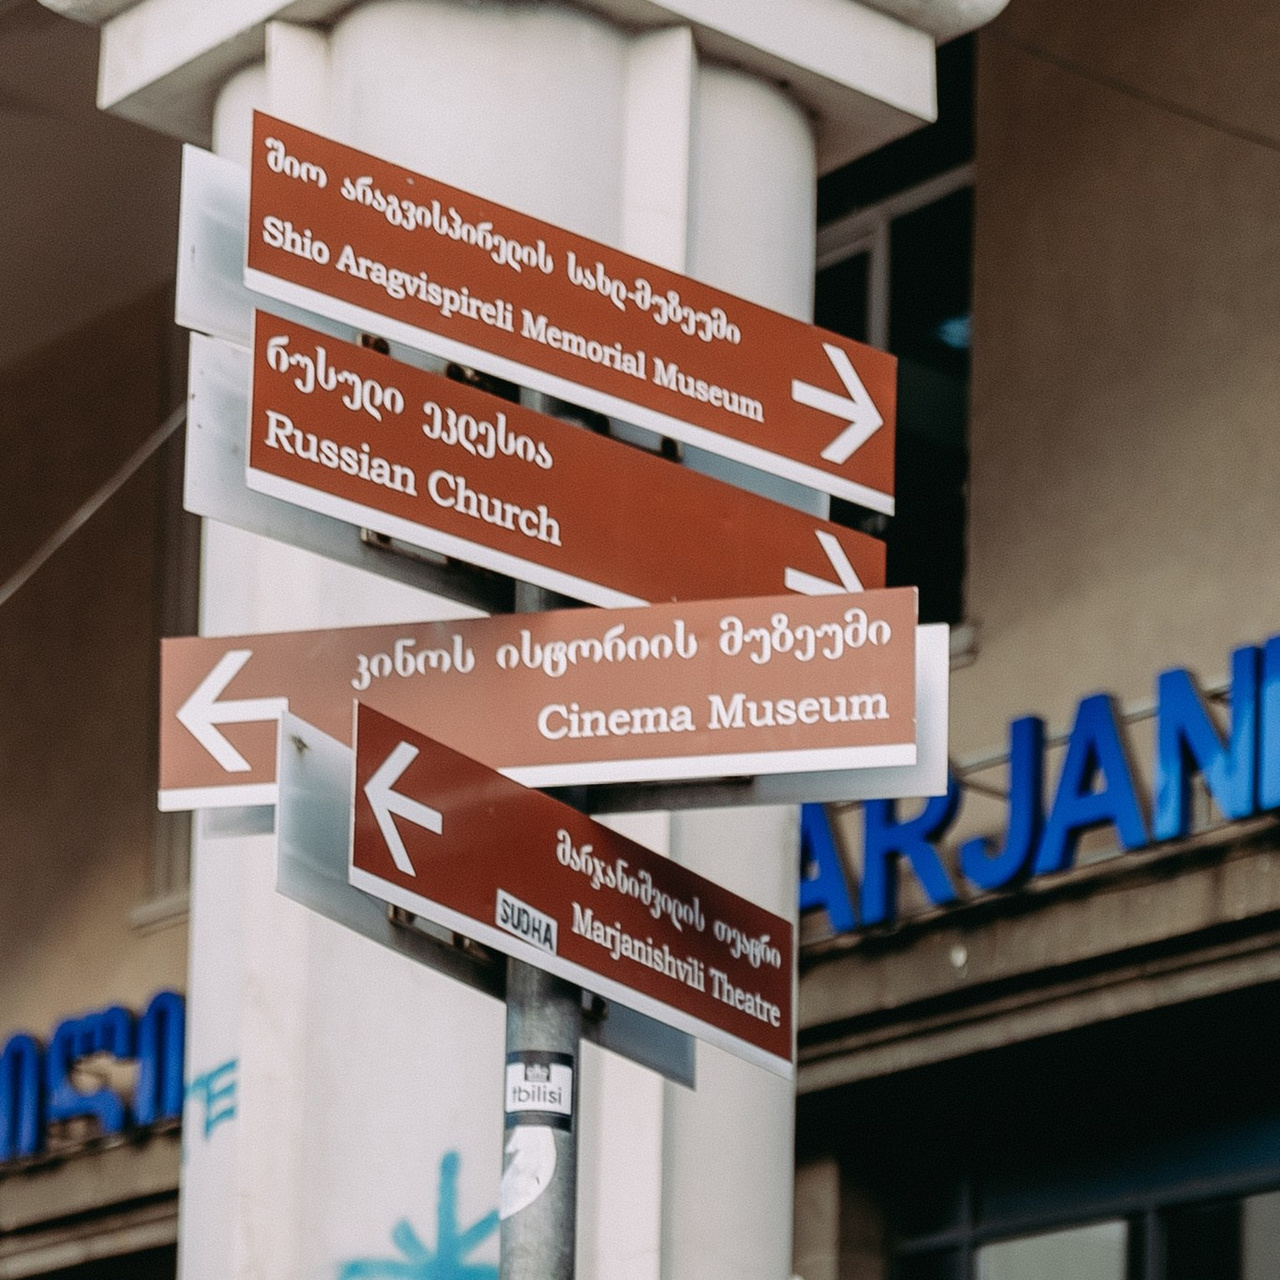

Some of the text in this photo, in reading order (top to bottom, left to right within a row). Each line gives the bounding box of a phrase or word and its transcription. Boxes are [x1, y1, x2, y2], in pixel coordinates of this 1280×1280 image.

[264, 136, 328, 189] შიო
[566, 250, 742, 345] სახლ-მუზეუმი
[261, 215, 765, 423] Shio Aragvispireli Memorial Museum
[266, 335, 553, 470] რუსული ეკლესია
[263, 408, 562, 547] Russian Church
[350, 607, 892, 691] კინოს ისტორიის მუზეუმი
[537, 693, 890, 740] Cinema Museum
[556, 828, 782, 970] მარჯანიშვილის თეატრი
[570, 900, 782, 1029] Marjanishvili Theatre
[511, 1084, 563, 1105] tbilisi
